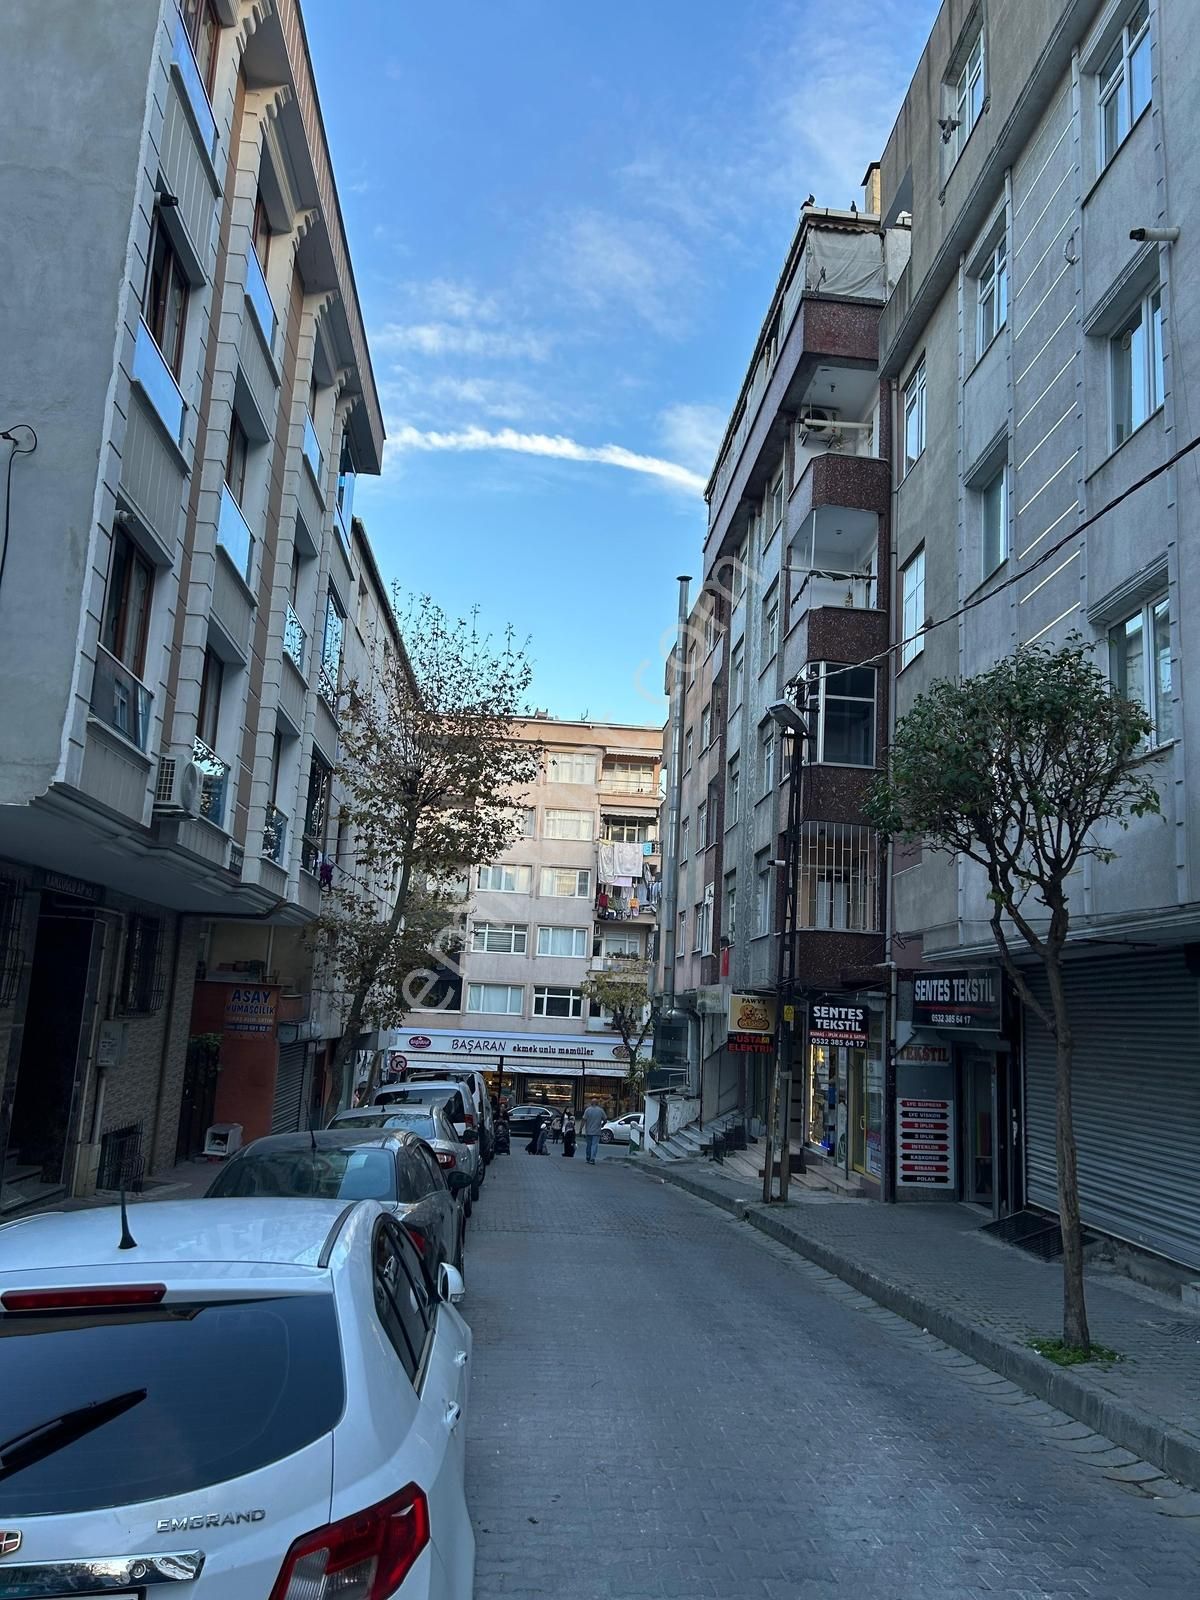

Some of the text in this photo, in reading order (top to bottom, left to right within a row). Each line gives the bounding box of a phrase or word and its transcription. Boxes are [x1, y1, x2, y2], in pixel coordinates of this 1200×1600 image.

[914, 971, 996, 1002] SENTES TEKSTİL
[232, 989, 271, 1003] ASAY
[813, 1006, 864, 1020] SENTES
[931, 1014, 971, 1024] 0532 385 64 17
[816, 1018, 862, 1032] TEKSTİL
[452, 1038, 594, 1056] BAŞARAN ekmek unlu mamüller
[830, 1038, 844, 1046] 385
[156, 1508, 266, 1533] EMGRAND
